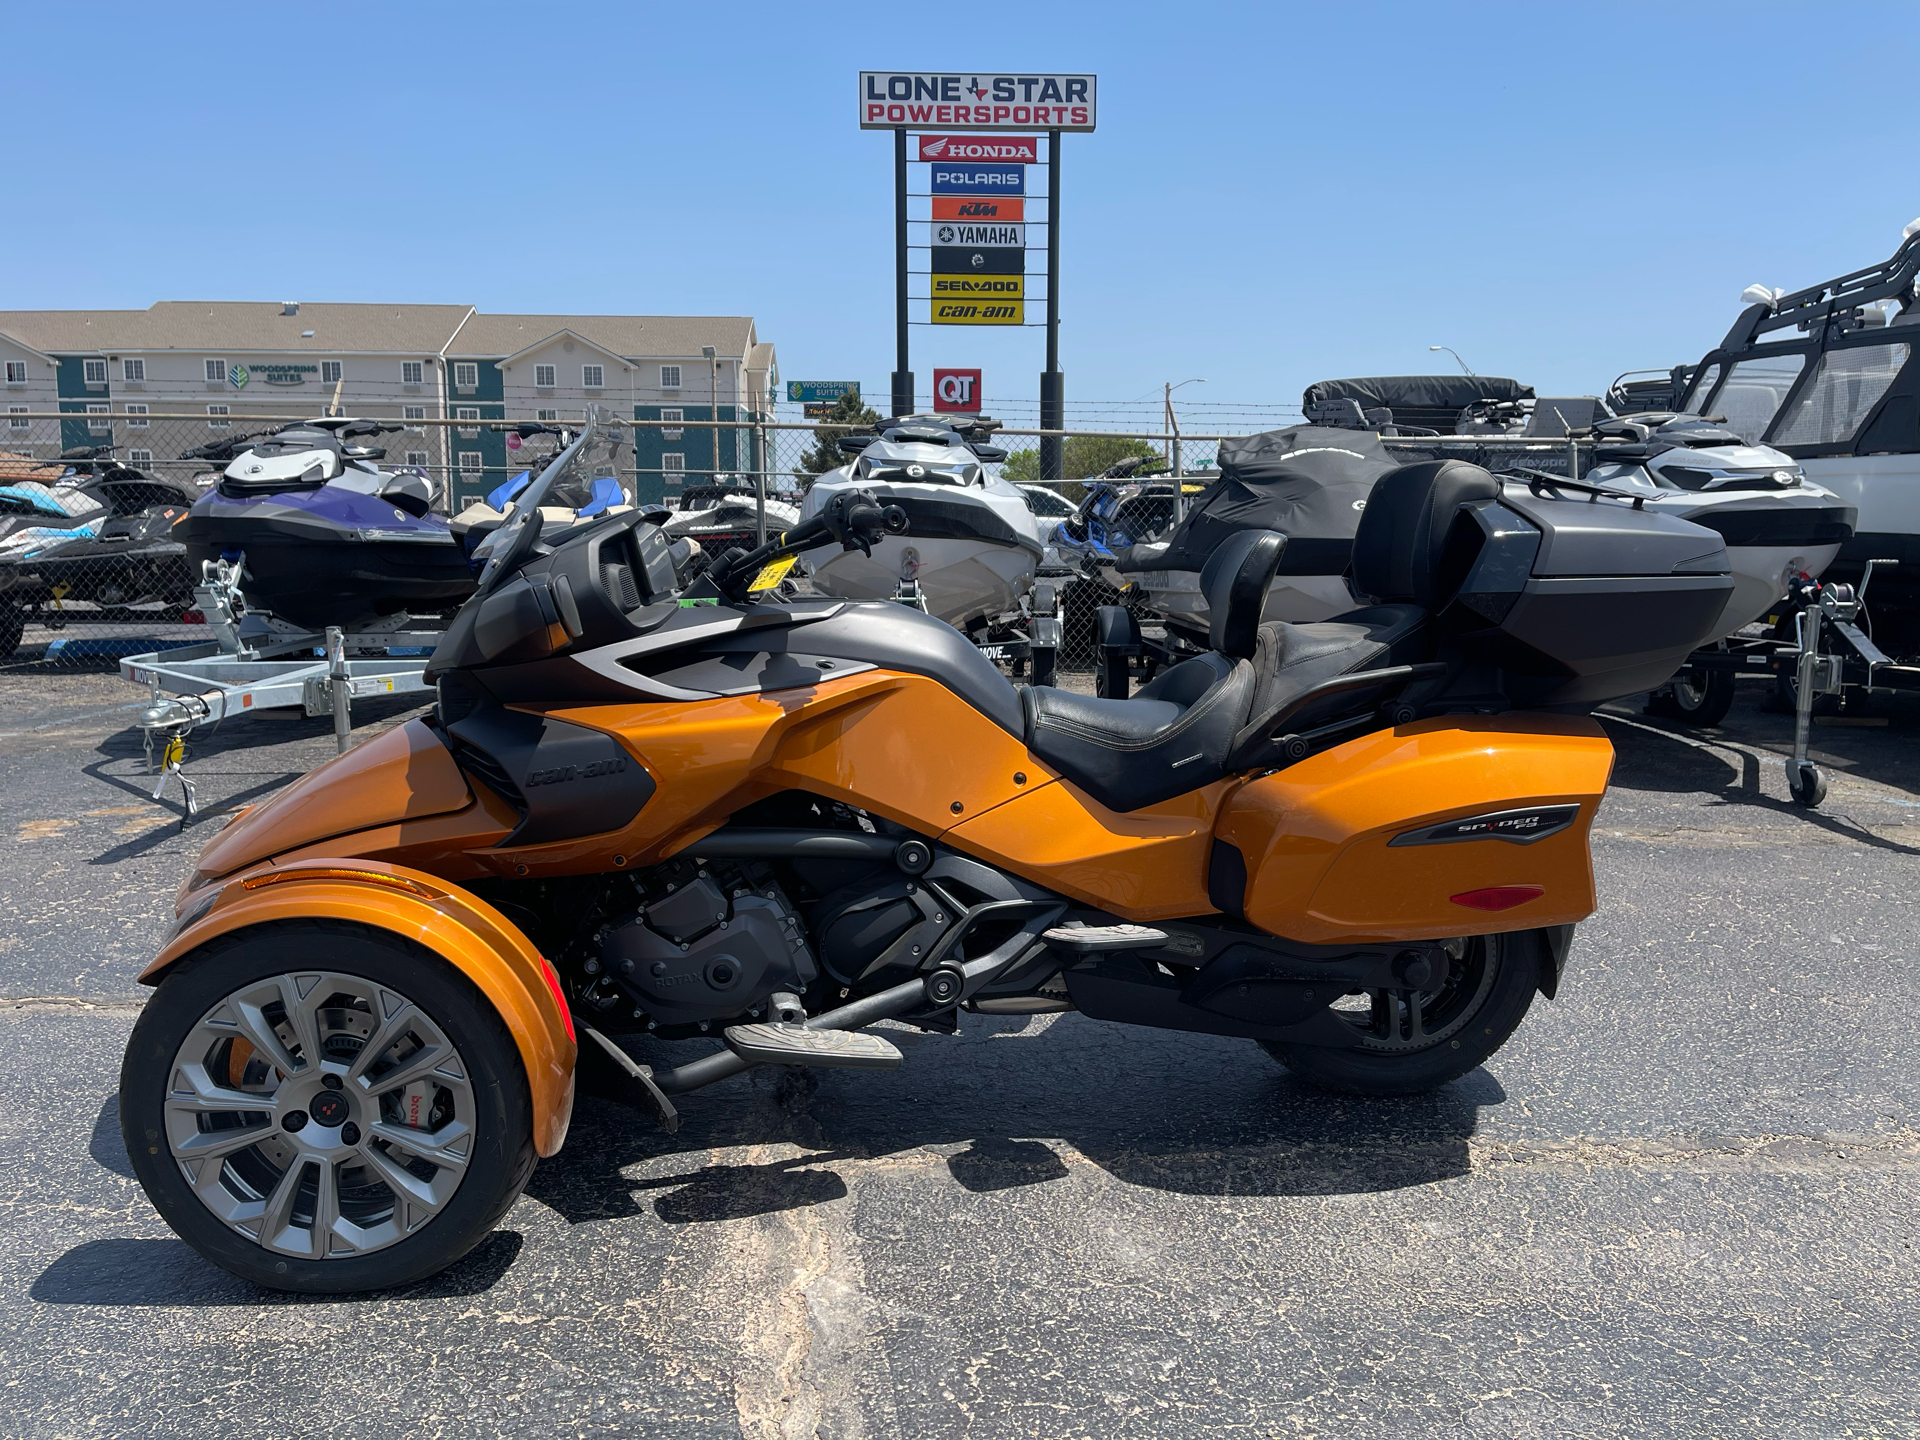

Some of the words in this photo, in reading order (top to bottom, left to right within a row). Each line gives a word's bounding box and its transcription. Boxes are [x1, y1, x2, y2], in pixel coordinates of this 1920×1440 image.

[867, 75, 961, 102] LONE
[992, 77, 1089, 103] STAR
[867, 103, 1088, 124] POWERSPORTS
[948, 144, 1034, 158] HONDA
[936, 172, 1020, 185] POLARIS
[958, 202, 998, 216] KTM
[957, 226, 1018, 244] YAMAHA
[938, 305, 1016, 318] can-am
[248, 364, 318, 373] WOODSPRING
[266, 373, 302, 382] SUITES
[802, 381, 858, 389] WOODSPRING
[816, 388, 845, 396] SUITES
[938, 375, 974, 404] QT
[134, 667, 147, 684] MOV
[525, 757, 628, 788] can-am
[1457, 816, 1540, 832] SPYDER
[1514, 822, 1538, 830] F3
[654, 971, 703, 989] ROTAX
[409, 1095, 423, 1127] brem
